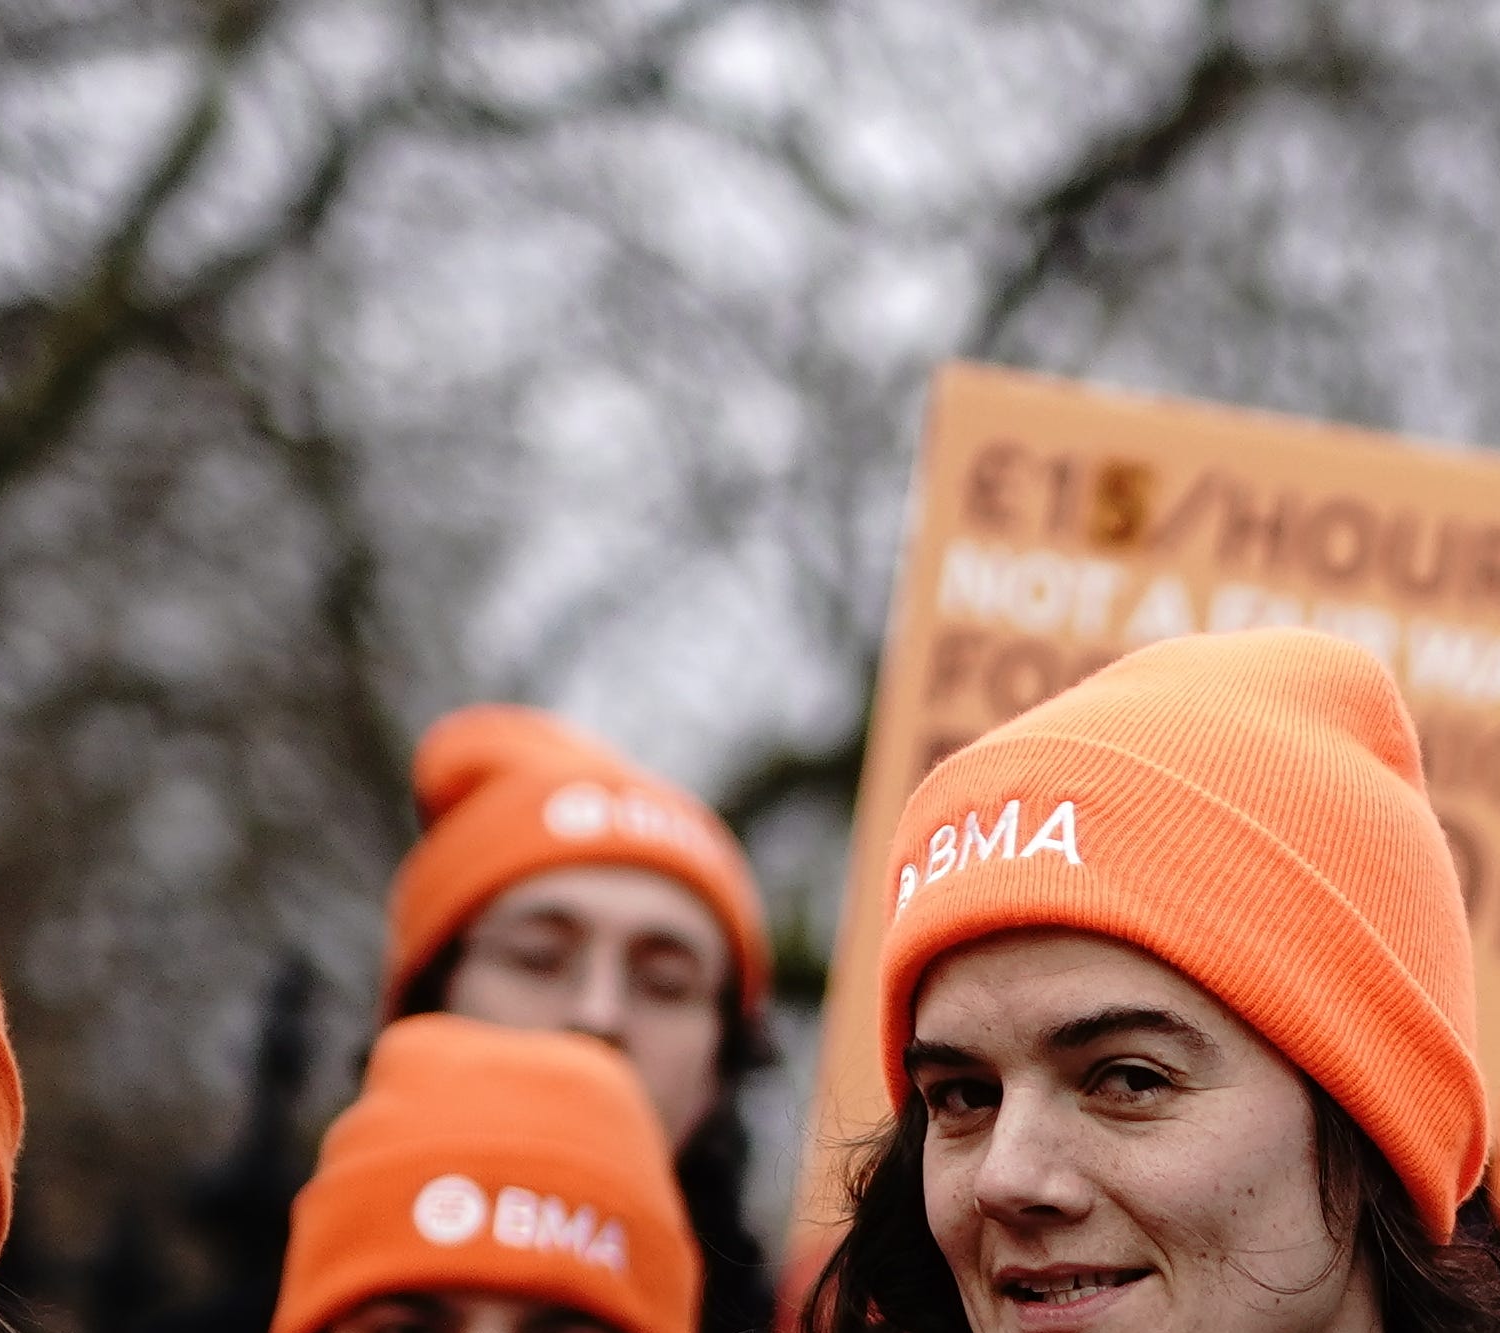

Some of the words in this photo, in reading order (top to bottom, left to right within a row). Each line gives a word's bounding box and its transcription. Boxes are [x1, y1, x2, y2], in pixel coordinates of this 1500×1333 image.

[939, 539, 1126, 632] NOT
[1120, 577, 1197, 641] A
[925, 798, 1081, 883] BMA
[492, 1185, 628, 1272] BMA
